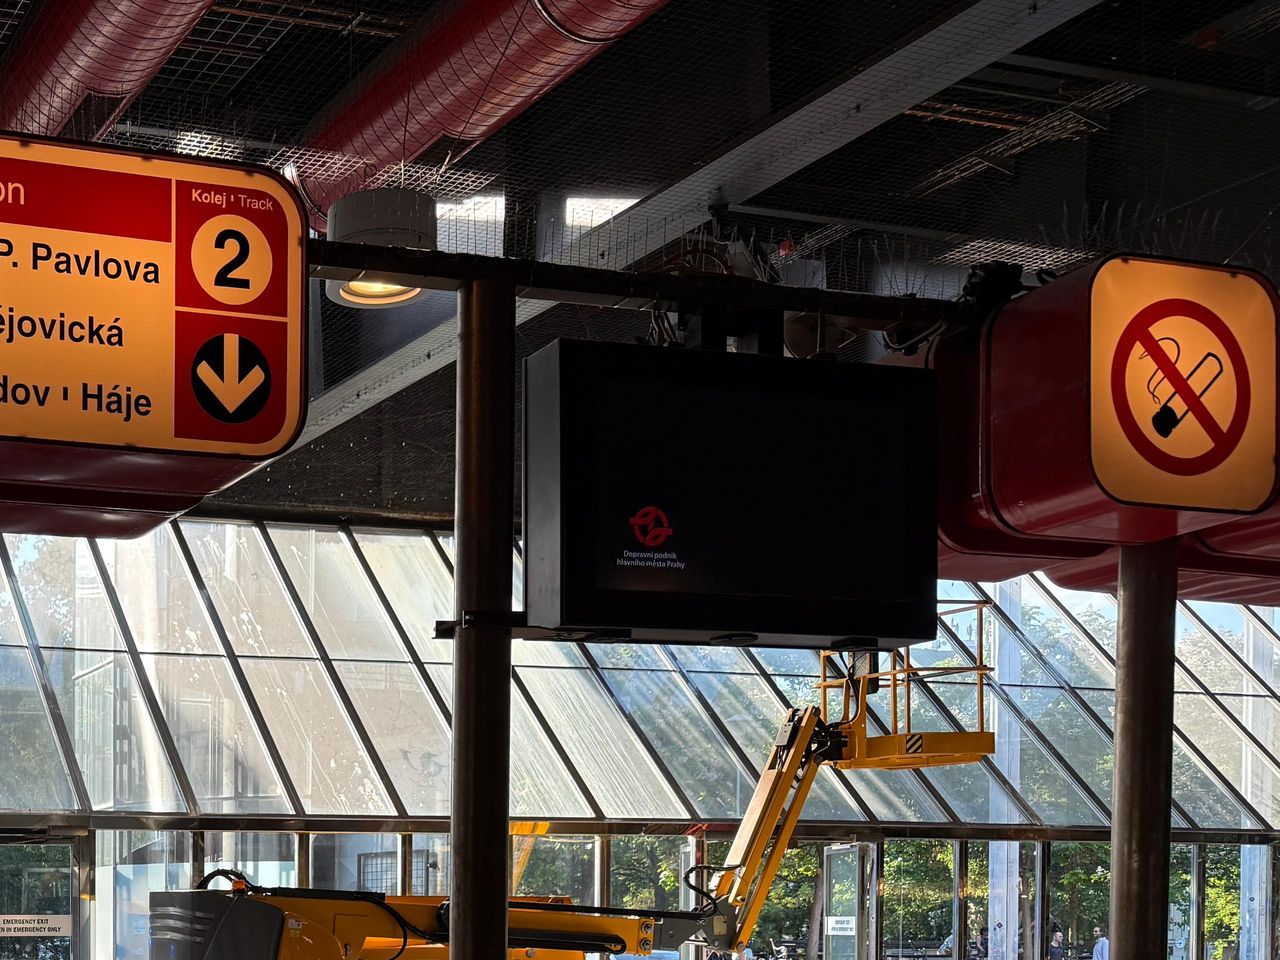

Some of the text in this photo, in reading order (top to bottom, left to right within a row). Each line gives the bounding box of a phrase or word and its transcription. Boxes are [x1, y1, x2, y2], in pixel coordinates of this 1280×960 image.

[191, 188, 274, 212] Kolej Track
[32, 243, 160, 284] Pavlova
[213, 228, 251, 289] 2
[81, 382, 152, 422] Háje
[616, 558, 686, 569] hlavního města Prahy
[623, 550, 677, 560] Dopravní podnik
